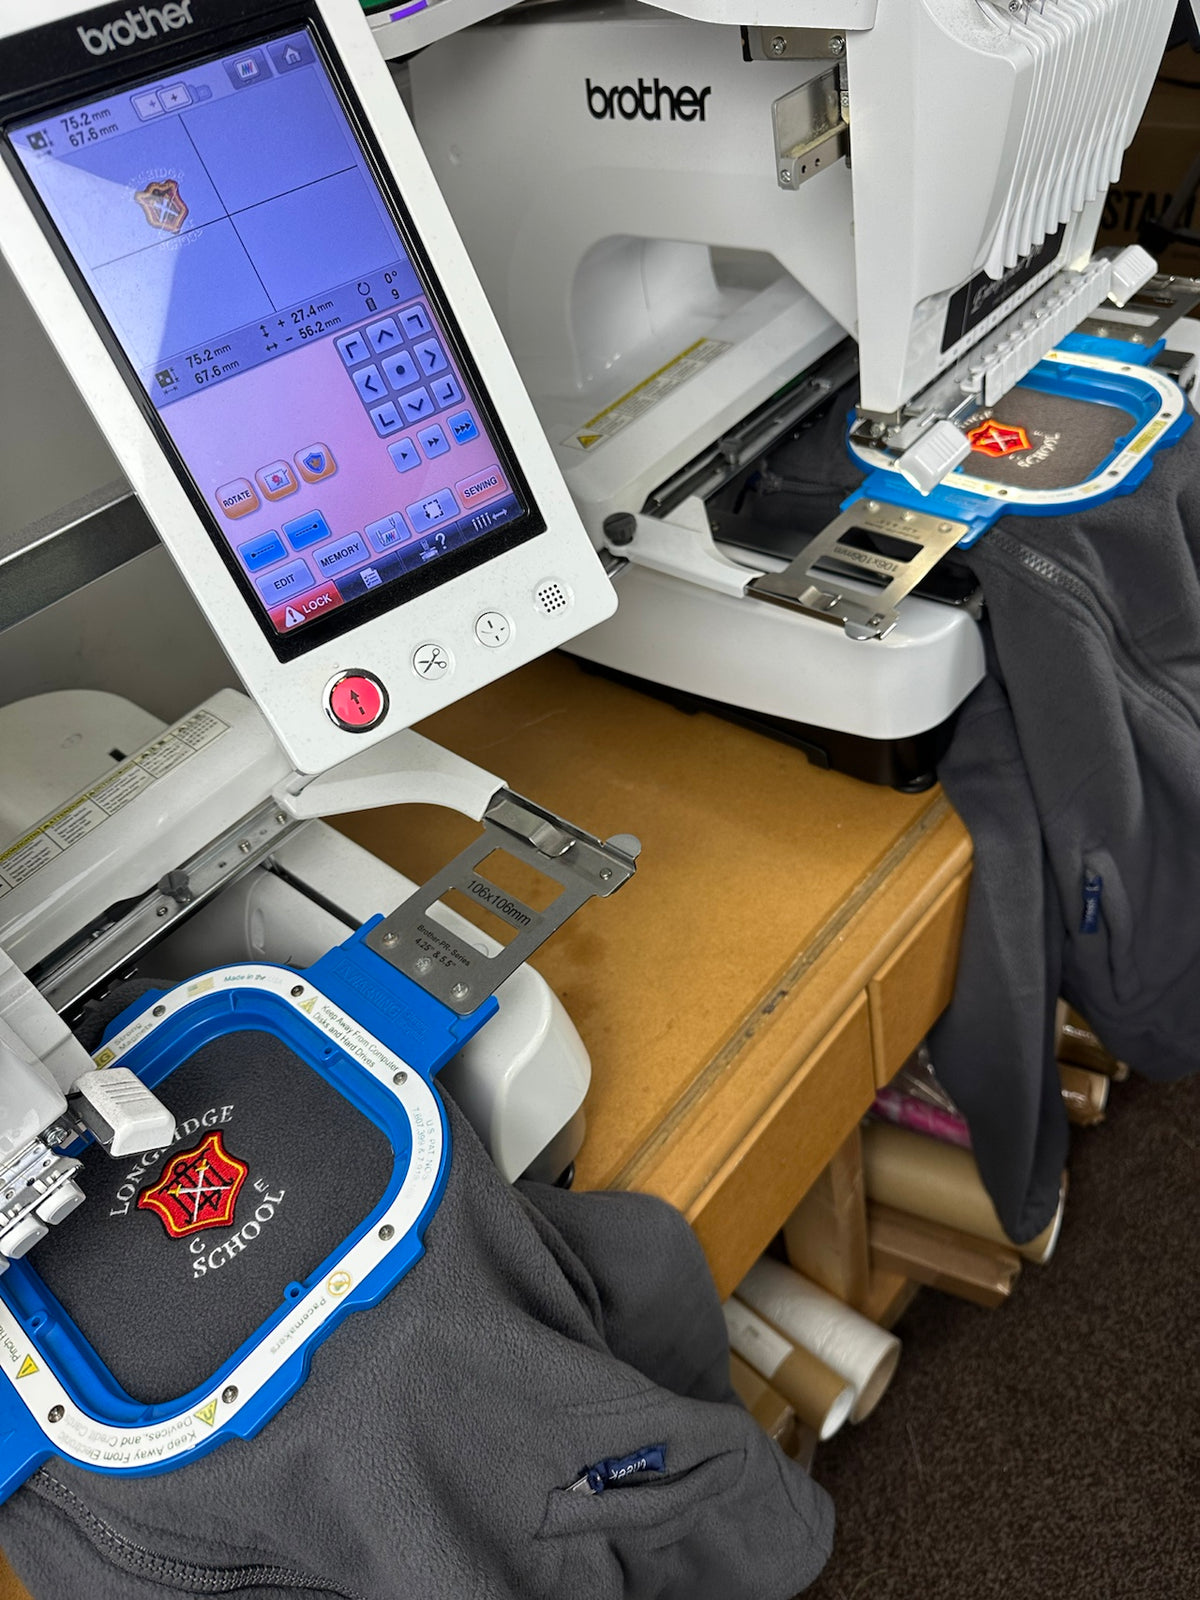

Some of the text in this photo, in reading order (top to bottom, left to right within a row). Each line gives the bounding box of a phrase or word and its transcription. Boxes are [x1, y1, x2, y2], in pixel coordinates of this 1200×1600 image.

[76, 0, 194, 56] brother
[585, 77, 712, 122] brother
[391, 288, 400, 300] 9
[222, 489, 252, 508] ROTATE
[464, 476, 498, 498] SEWING
[320, 542, 361, 568] MEMORY
[273, 574, 296, 590] EDIT
[302, 593, 333, 614] LOCK
[467, 880, 532, 926] 106x106mm
[312, 1011, 376, 1068] Disks and Hard Drives
[321, 1004, 400, 1072] Keep Away From Computer
[109, 1104, 235, 1218] LONGIDGE
[189, 1178, 270, 1254] C E
[192, 1189, 286, 1279] SCHOOL
[270, 1296, 327, 1354] Pacemakers
[4, 1337, 21, 1362] Pinch
[145, 1415, 194, 1441] Devices,
[167, 1430, 197, 1450] Keep
[121, 1437, 142, 1448] and
[133, 1445, 165, 1461] Away
[103, 1453, 130, 1464] From
